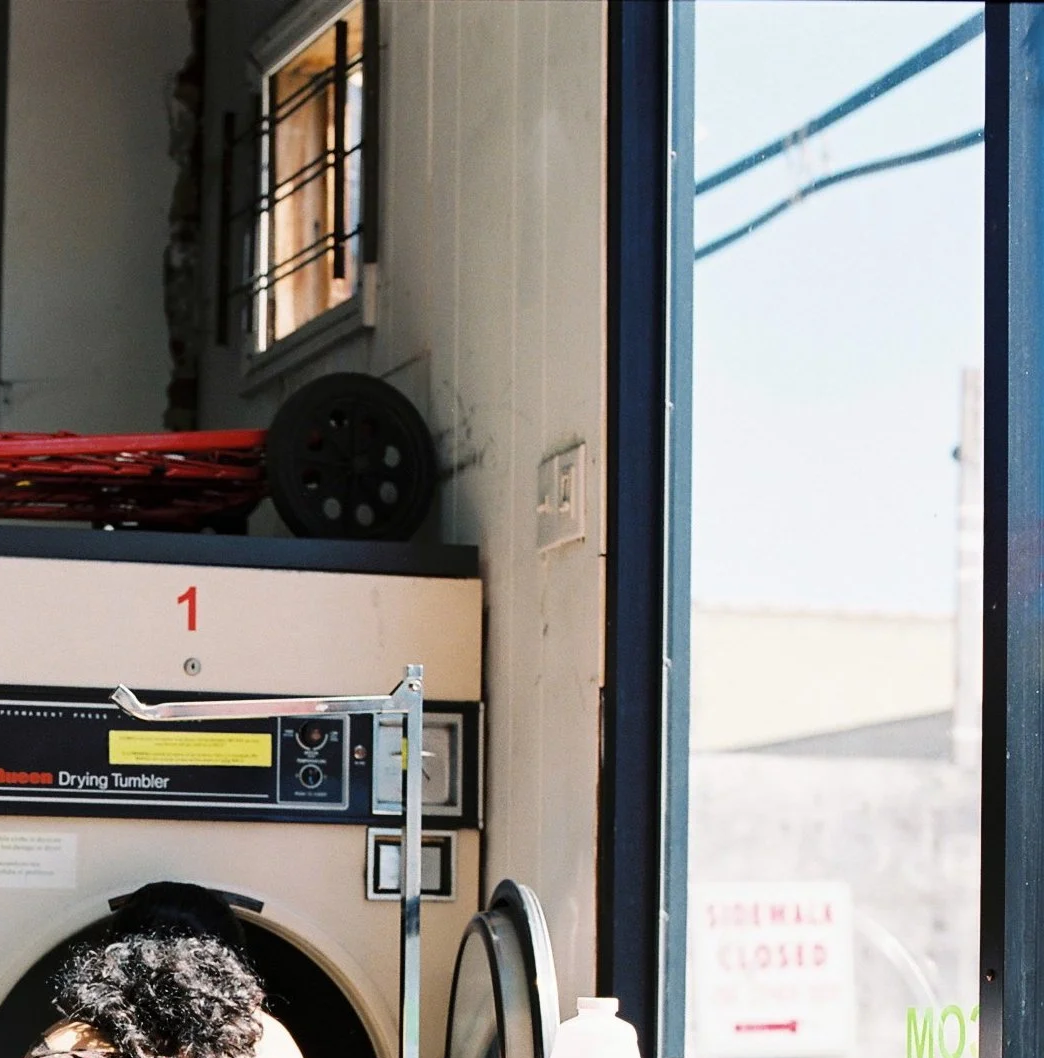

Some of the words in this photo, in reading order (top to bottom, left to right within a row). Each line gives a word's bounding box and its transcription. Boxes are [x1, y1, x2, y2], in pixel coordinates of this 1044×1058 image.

[176, 585, 198, 632] 1
[58, 770, 108, 789] Drying
[111, 773, 170, 789] Tumbler
[707, 903, 834, 930] SIDEWALK
[717, 942, 828, 971] CLOSED
